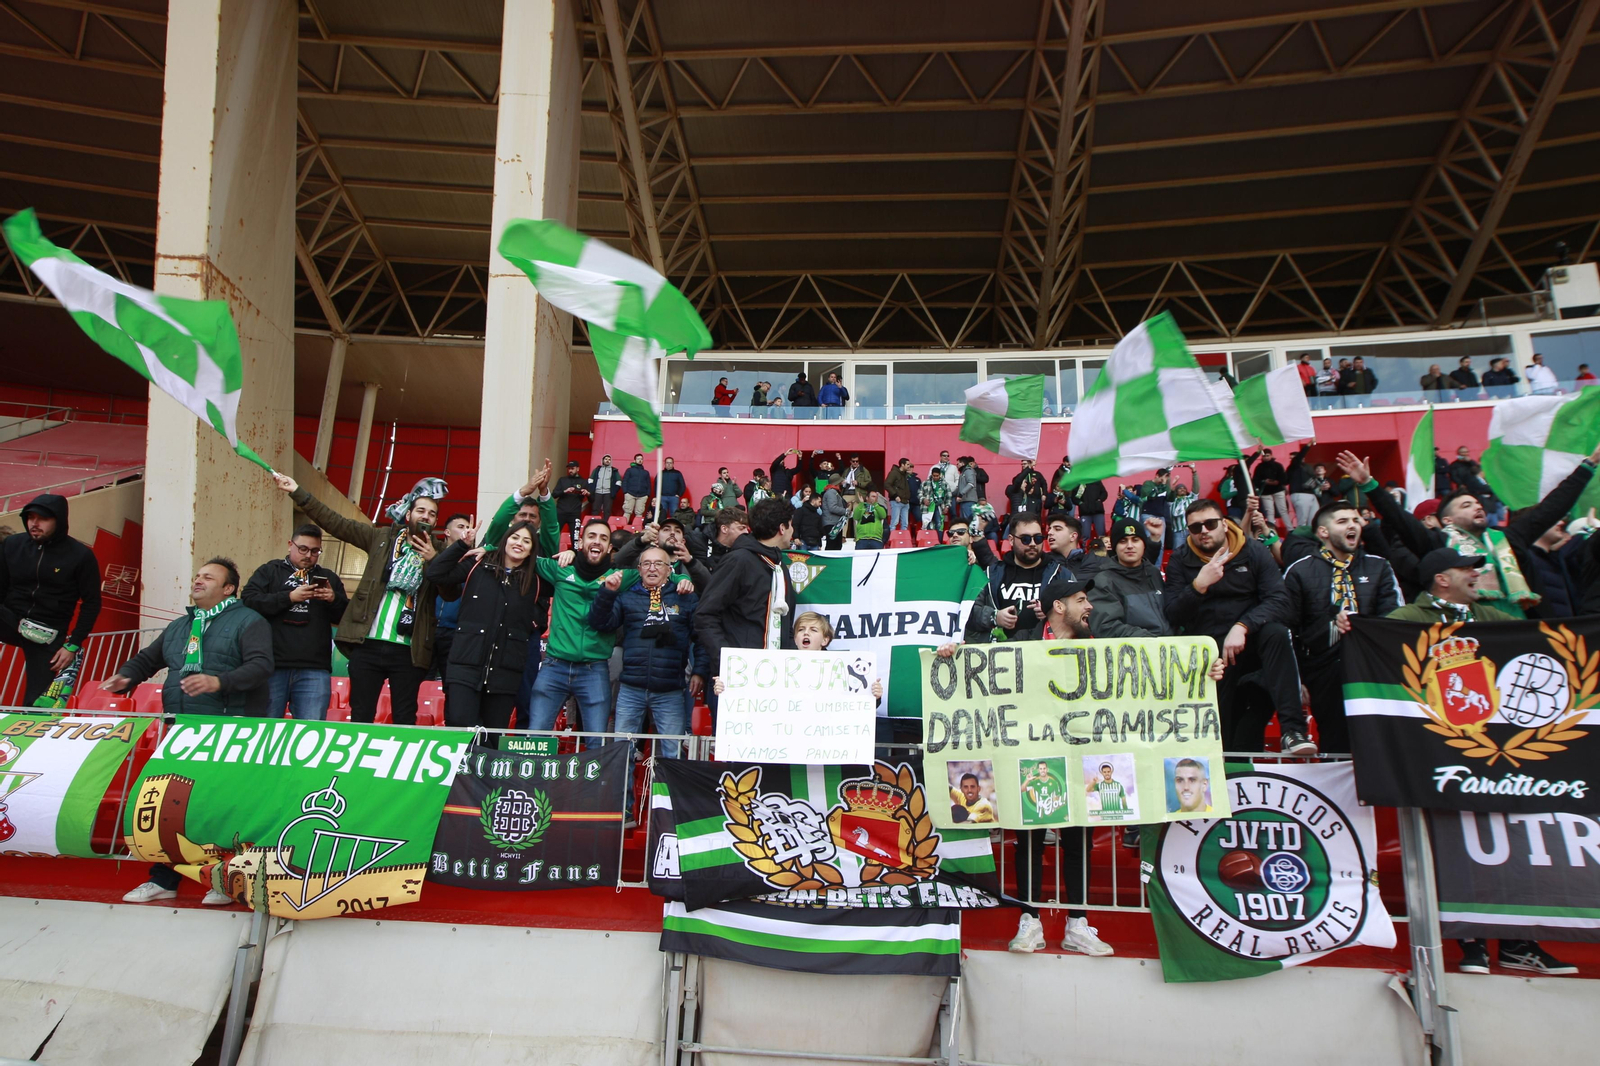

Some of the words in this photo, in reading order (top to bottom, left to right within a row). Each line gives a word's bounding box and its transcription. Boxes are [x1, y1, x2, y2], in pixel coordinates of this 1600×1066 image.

[1000, 583, 1041, 601] VAN
[824, 610, 961, 640] AMPAN
[726, 655, 847, 691] BORJA
[1047, 643, 1211, 701] JUANMI
[724, 698, 778, 713] VENGO
[788, 700, 803, 712] DE
[815, 701, 871, 713] UMBRETE
[2, 718, 134, 743] BÉTICA
[724, 721, 754, 735] POR
[772, 723, 793, 735] TU
[803, 724, 871, 736] CAMISETA
[926, 704, 1019, 753] DAME
[1028, 722, 1055, 742] LA
[1059, 702, 1220, 745] CAMISETA
[153, 722, 468, 786] CARMOBETIS
[508, 741, 537, 751] SALIDA
[537, 742, 549, 751] DE
[1432, 765, 1589, 799] Fanáticos
[1218, 820, 1302, 851] JVTD
[1459, 812, 1600, 867] UTR
[432, 852, 508, 881] Betis
[518, 859, 601, 885] Fans
[1173, 864, 1185, 874] 20
[336, 896, 391, 915] 2017
[1234, 893, 1307, 921] 1907
[1190, 904, 1262, 957] REAL
[1284, 900, 1359, 954] BETIS
